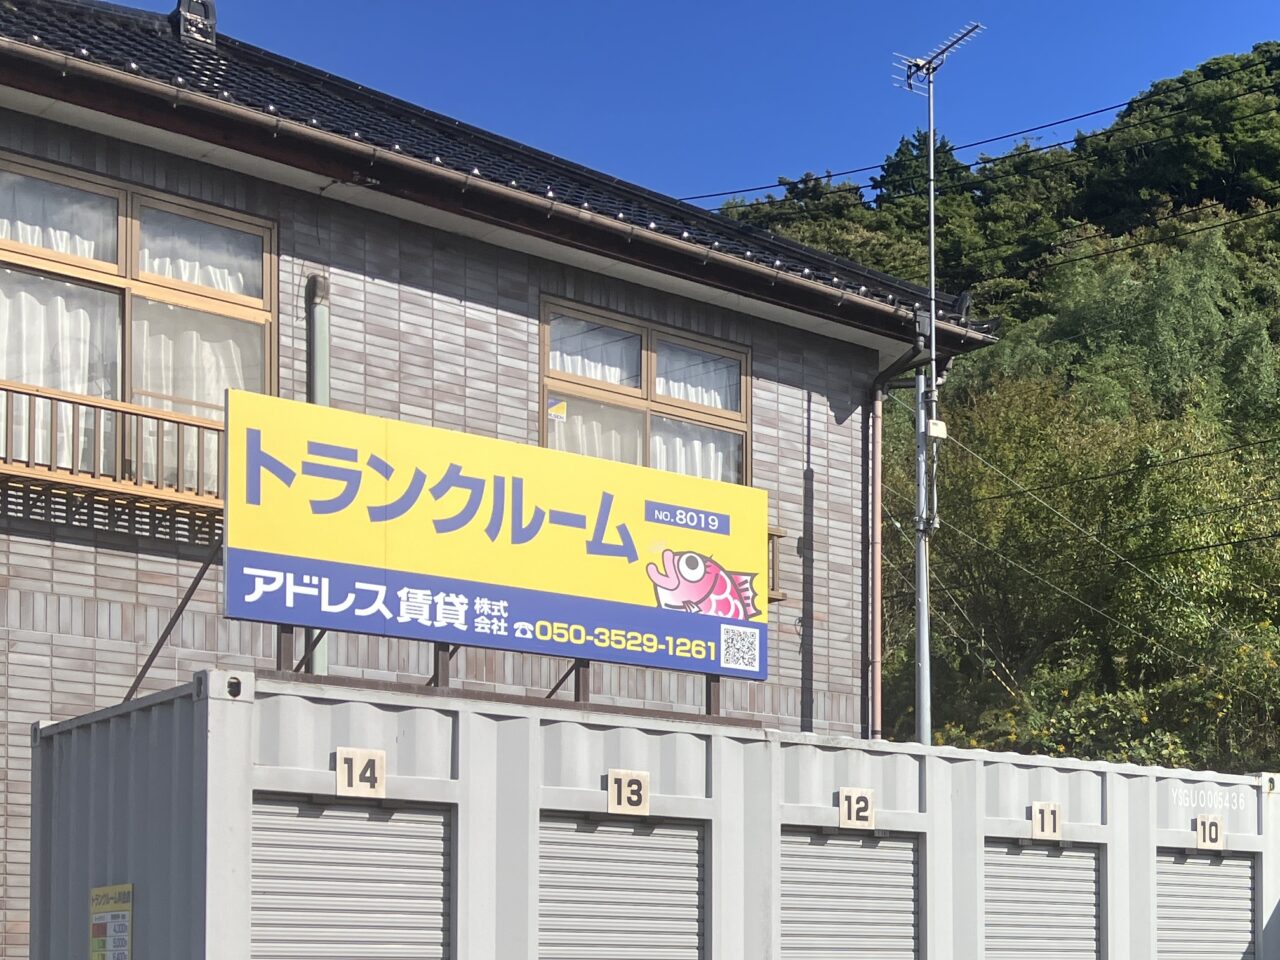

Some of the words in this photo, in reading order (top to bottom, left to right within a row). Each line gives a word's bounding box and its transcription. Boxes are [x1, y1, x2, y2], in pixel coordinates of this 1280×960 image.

[245, 427, 639, 564] トランクルーム
[243, 566, 469, 632] アドレス賃貸
[534, 620, 717, 661] 050-3529-1261
[343, 757, 378, 789] 14
[613, 777, 643, 807] 13
[844, 794, 869, 822] 12
[1038, 808, 1057, 834] 11
[1200, 820, 1219, 844] 10
